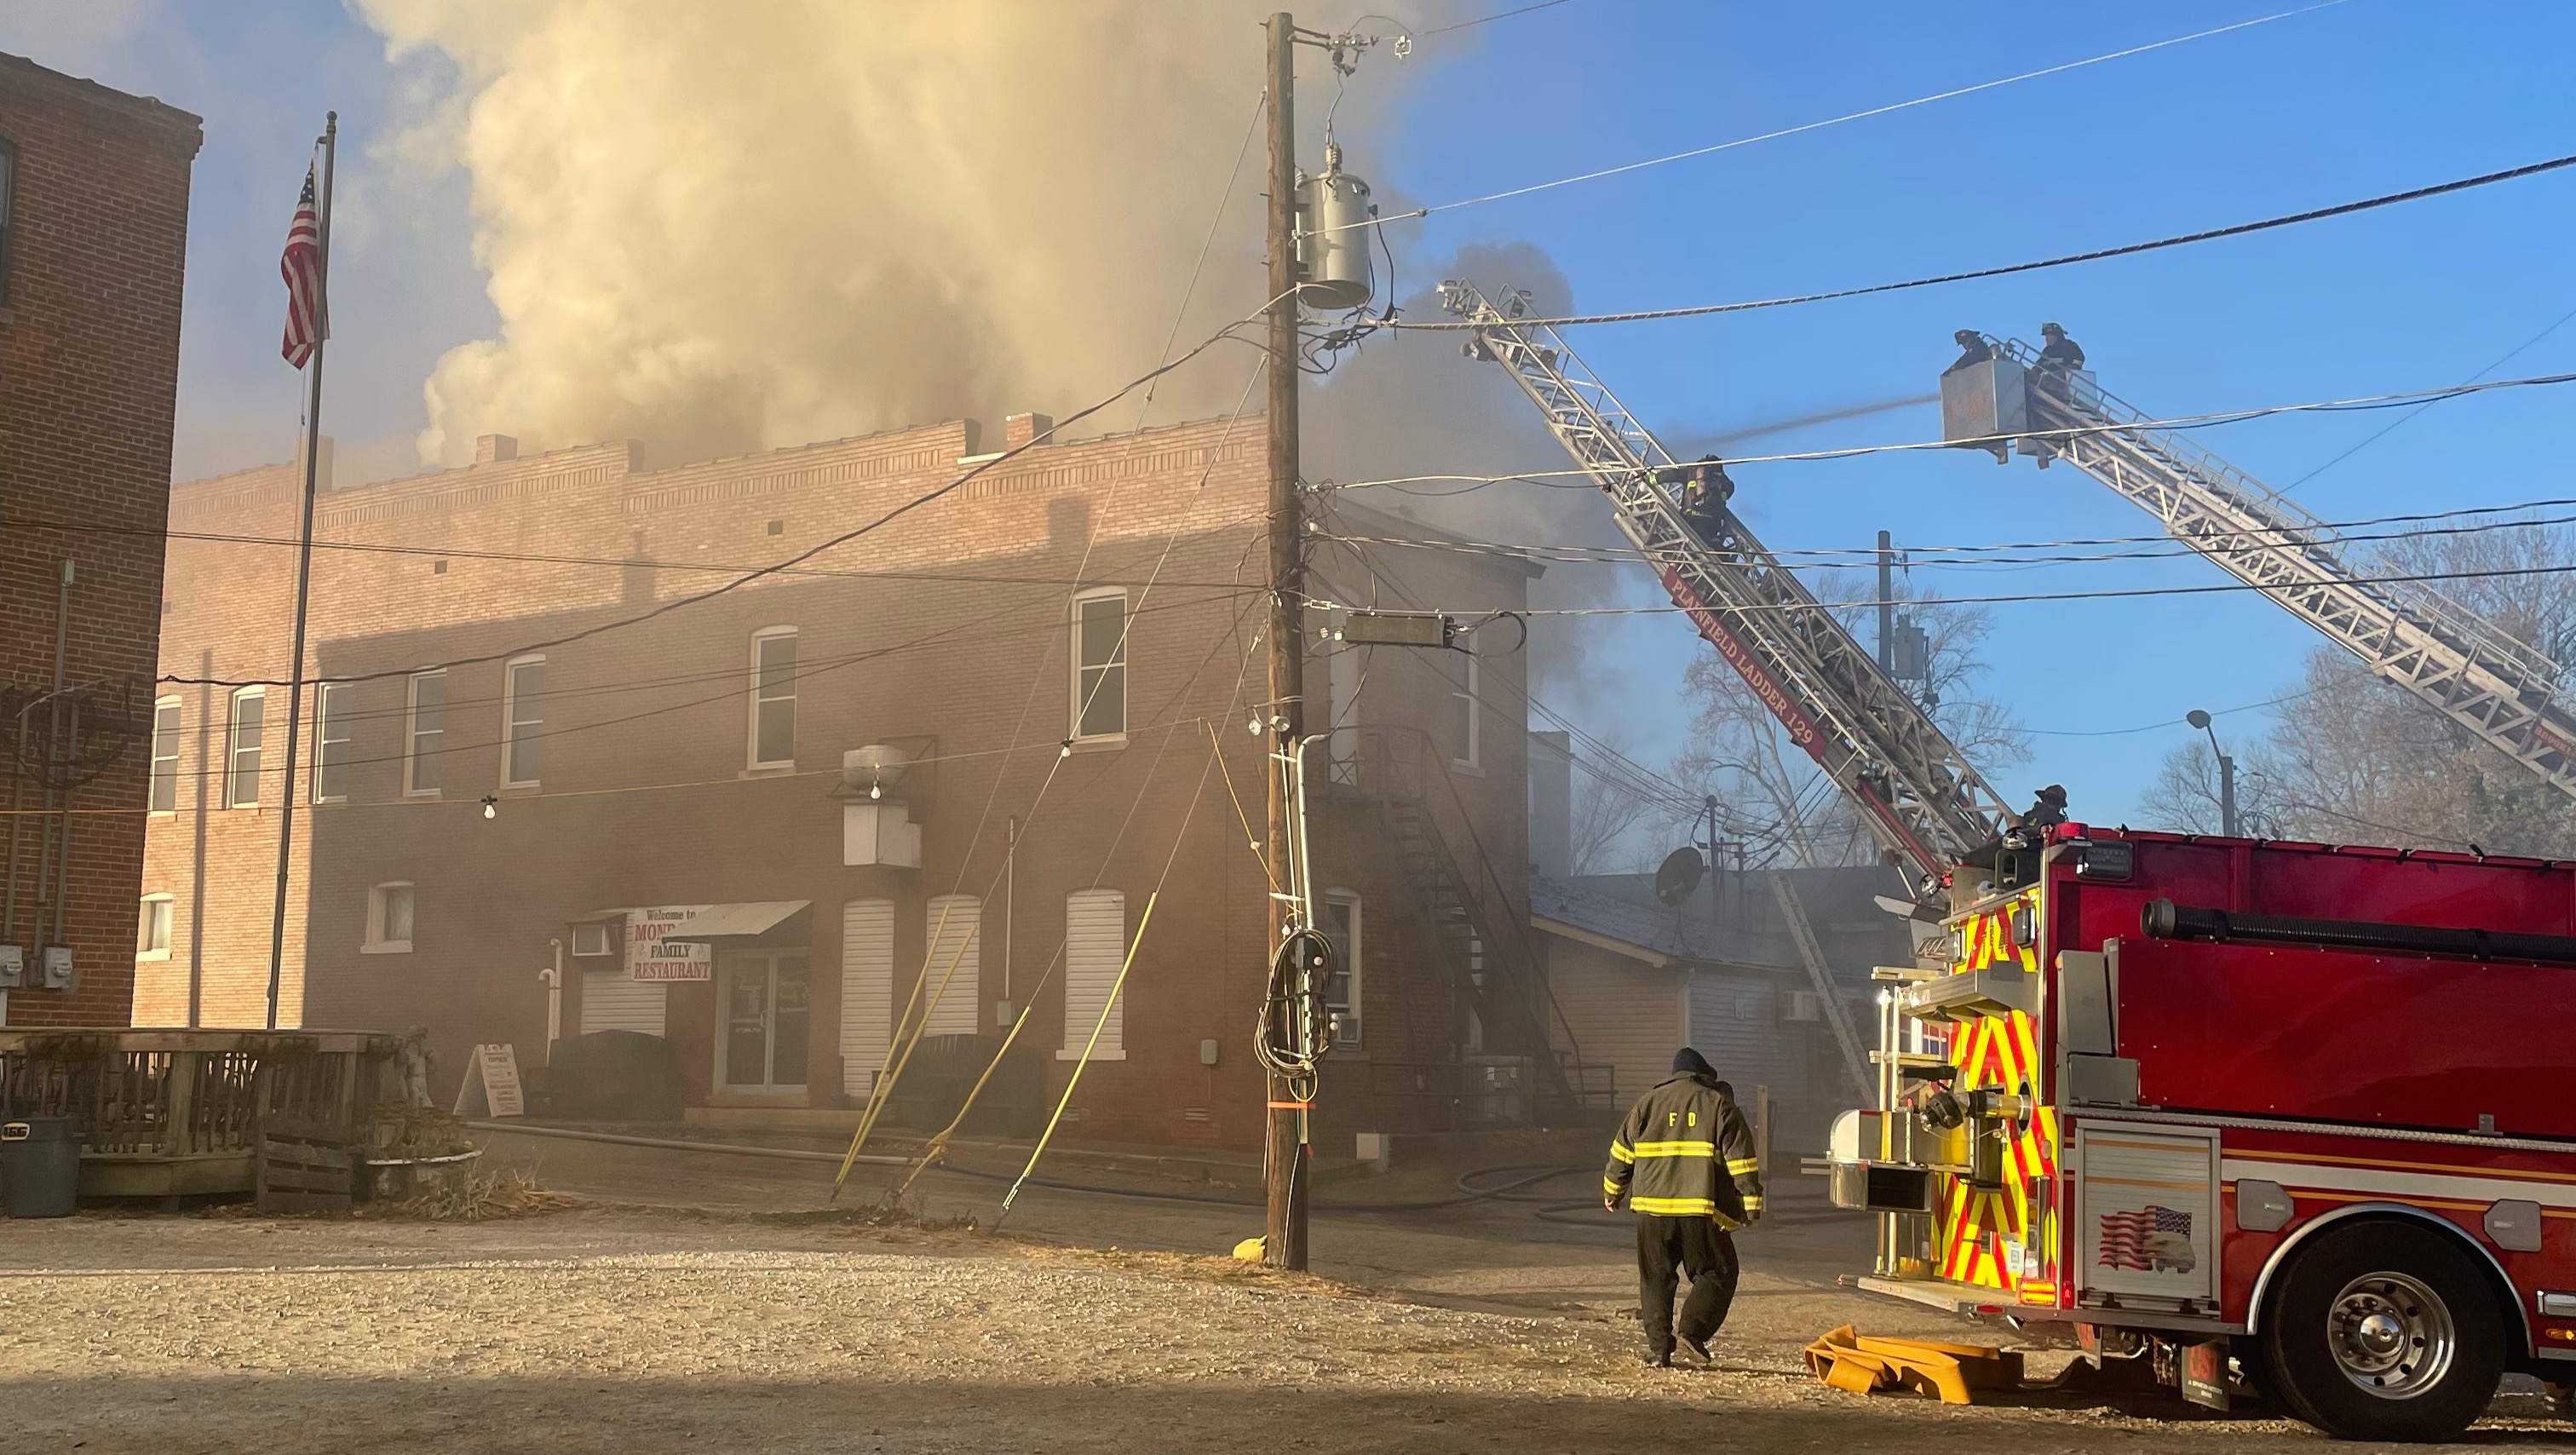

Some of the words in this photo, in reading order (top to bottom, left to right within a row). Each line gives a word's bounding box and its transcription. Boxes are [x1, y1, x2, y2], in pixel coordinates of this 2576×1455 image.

[1671, 579, 1737, 658] PLAINFIELD
[1736, 653, 1788, 716] LADDER
[1786, 713, 1813, 744] 129
[647, 909, 684, 921] Welcome
[687, 909, 696, 920] to
[650, 945, 691, 958] FAMILY
[634, 961, 710, 980] RESTAURANT
[1669, 1113, 1677, 1127] F
[1688, 1112, 1696, 1127] D
